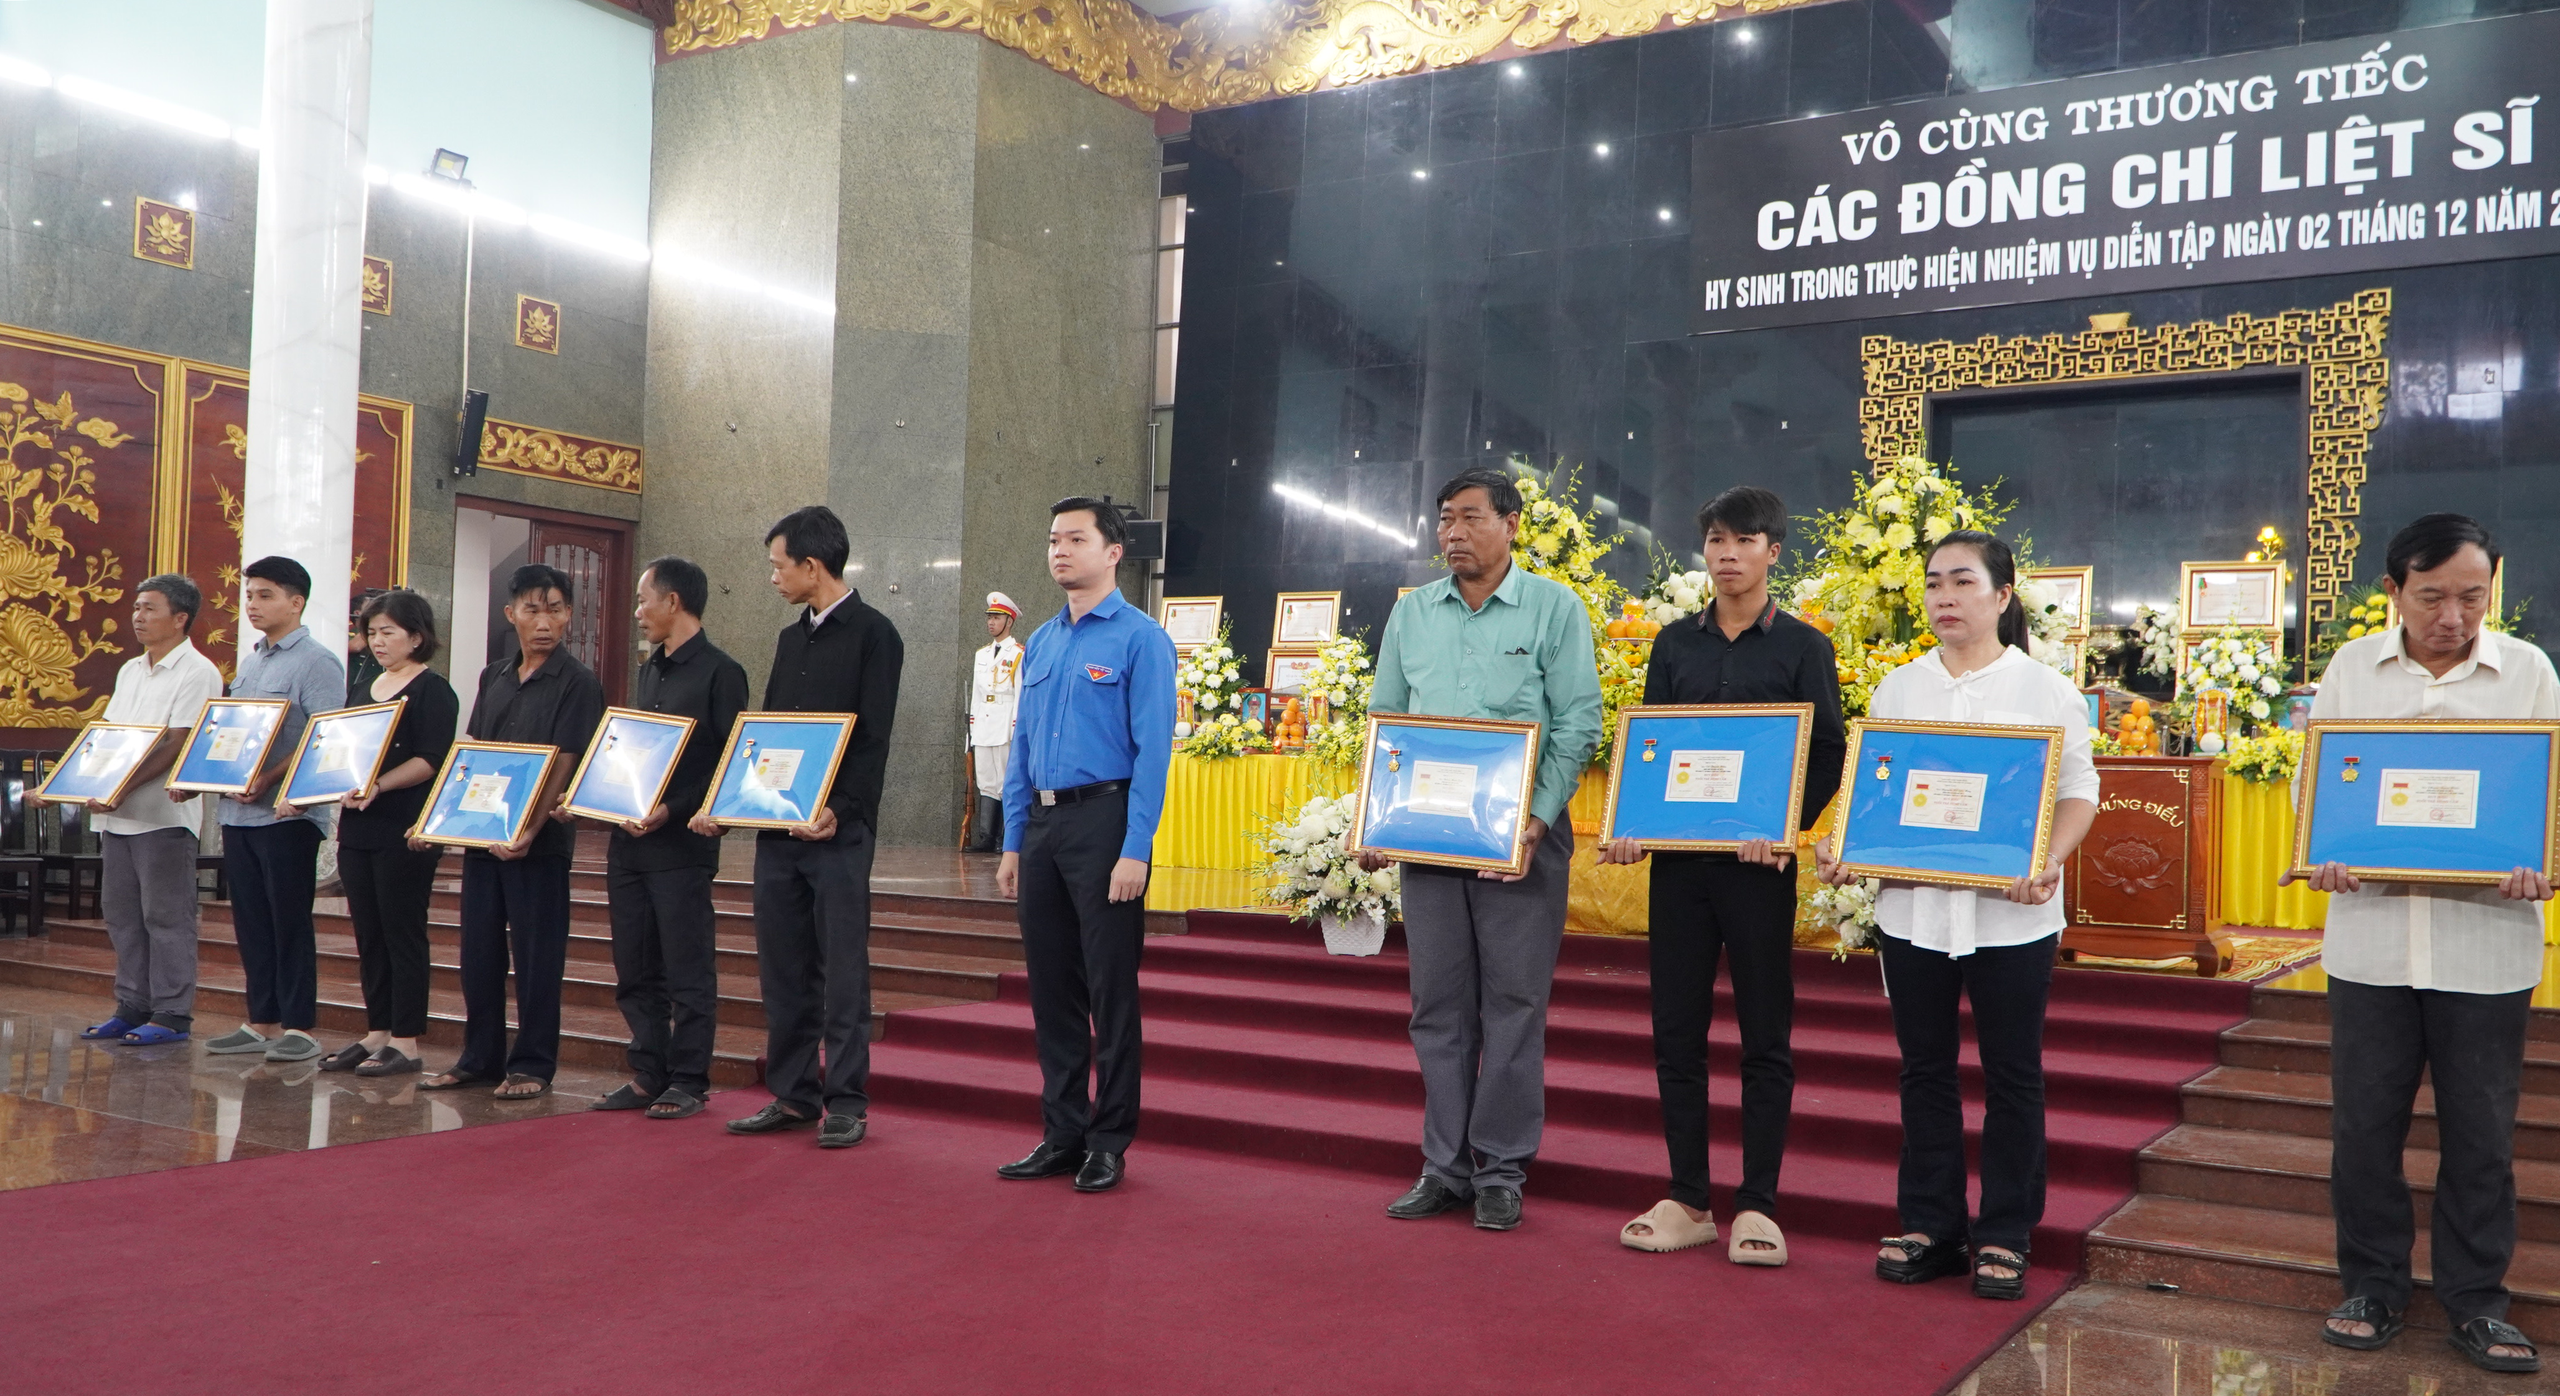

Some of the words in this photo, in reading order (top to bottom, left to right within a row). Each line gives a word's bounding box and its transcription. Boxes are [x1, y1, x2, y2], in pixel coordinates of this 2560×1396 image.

[1841, 119, 1901, 166] VÔ
[1918, 106, 2050, 155] CÙNG
[2063, 73, 2279, 136] THƯƠNG
[2294, 39, 2430, 105] TIẾC
[1757, 183, 1878, 251] CÁC
[1897, 156, 2087, 235] ĐỒNG
[2111, 129, 2238, 210] CHÍ
[2260, 113, 2426, 196] LIỆT
[2451, 94, 2541, 171] SĨ
[1705, 278, 1732, 311] HY
[1735, 272, 1786, 309] SINH
[1790, 264, 1859, 303] TRONG
[1863, 253, 1918, 300] THỰC
[1923, 245, 1978, 293] HIỆN
[1983, 237, 2061, 286] NHIỆM
[2066, 237, 2098, 280] VỤ
[2102, 220, 2162, 271] DIỄN
[2167, 219, 2216, 271] TẬP
[2222, 210, 2292, 259] NGÀY
[2297, 212, 2331, 251] 02
[2337, 198, 2427, 247] THÁNG
[2434, 198, 2468, 238] 12
[2475, 186, 2542, 234] NĂM
[2096, 792, 2142, 814] HÚNG
[2143, 801, 2184, 828] ĐIẾU
